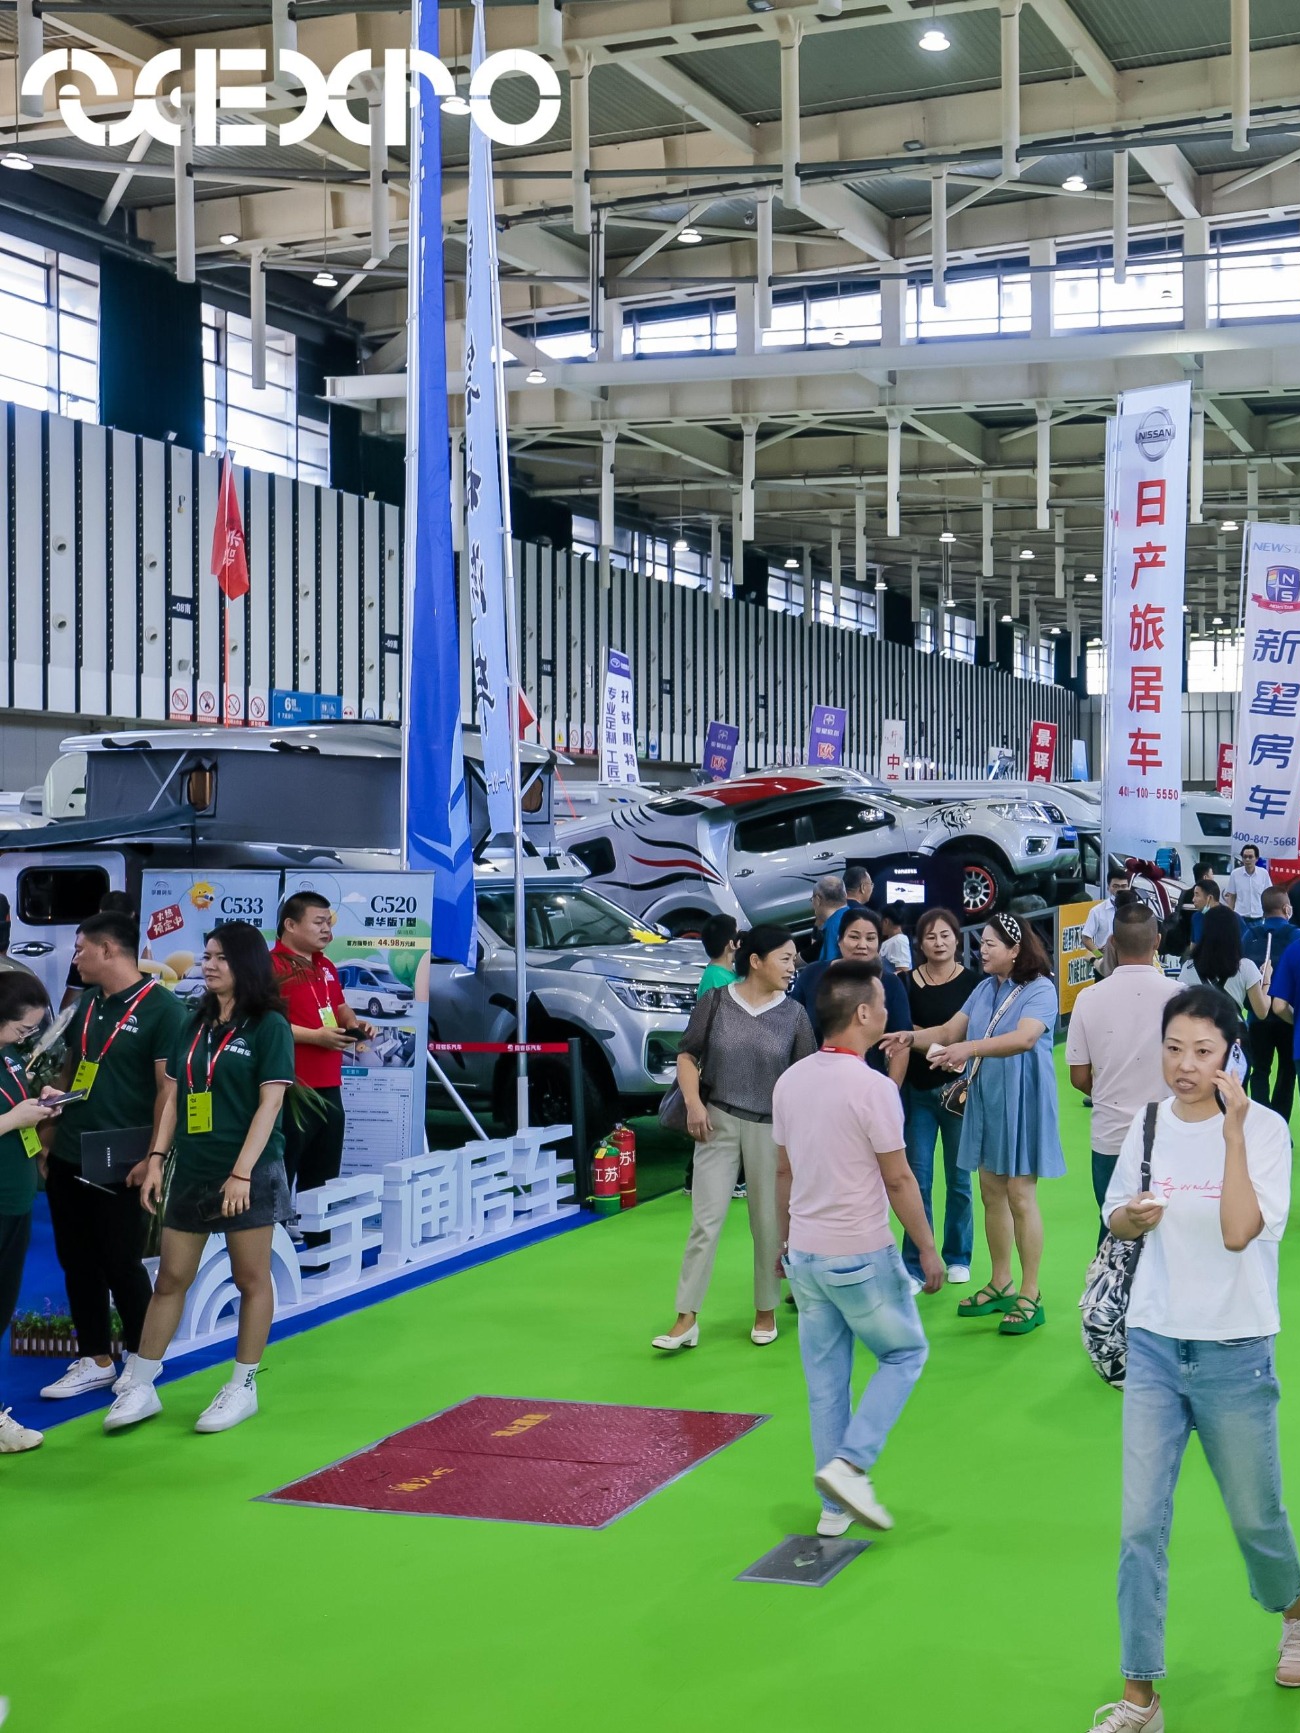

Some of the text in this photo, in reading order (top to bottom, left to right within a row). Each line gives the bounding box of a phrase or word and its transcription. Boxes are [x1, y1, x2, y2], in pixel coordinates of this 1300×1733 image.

[1138, 428, 1172, 440] NISSAN
[1127, 479, 1167, 776] 日产旅居车
[1233, 831, 1297, 847] 400-847-5668
[220, 896, 264, 915] C533
[370, 895, 417, 914] C520
[364, 916, 417, 927] 豪华版T型
[297, 1124, 581, 1296] 宇通房车
